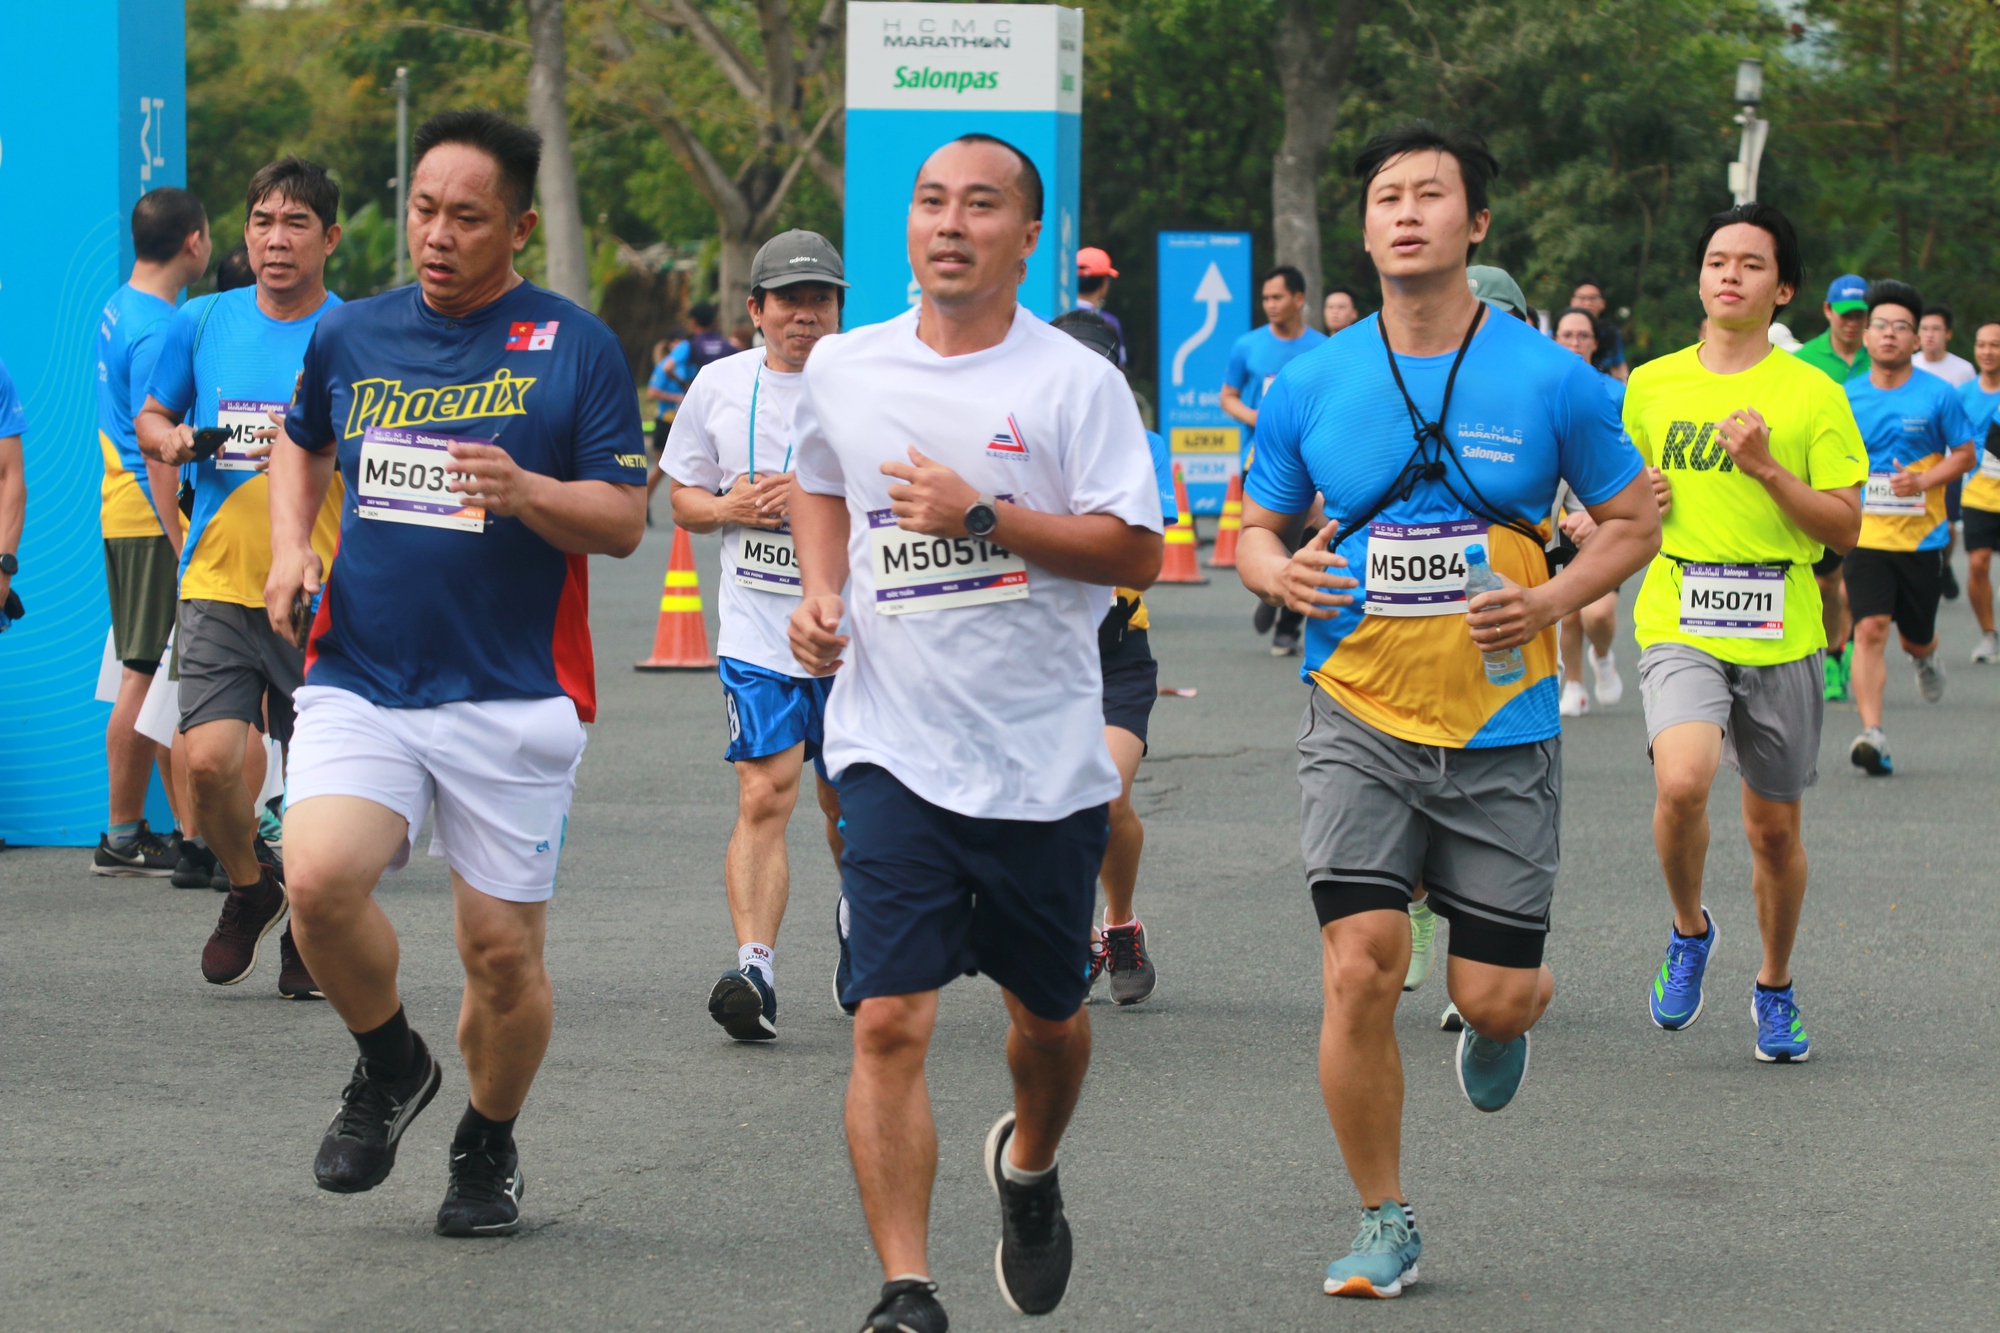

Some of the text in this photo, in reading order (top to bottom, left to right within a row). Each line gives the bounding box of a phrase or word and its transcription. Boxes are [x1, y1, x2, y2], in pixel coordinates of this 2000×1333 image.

[883, 36, 1011, 49] MARATHON
[893, 66, 999, 94] Salonpas
[344, 368, 537, 440] Phoenix
[415, 435, 448, 448] Salonpas
[1458, 430, 1523, 445] MARATHON
[1461, 445, 1516, 463] Salonpas
[1407, 527, 1441, 536] Salonpas
[882, 538, 1012, 575] M50514
[1690, 588, 1773, 612] M50711
